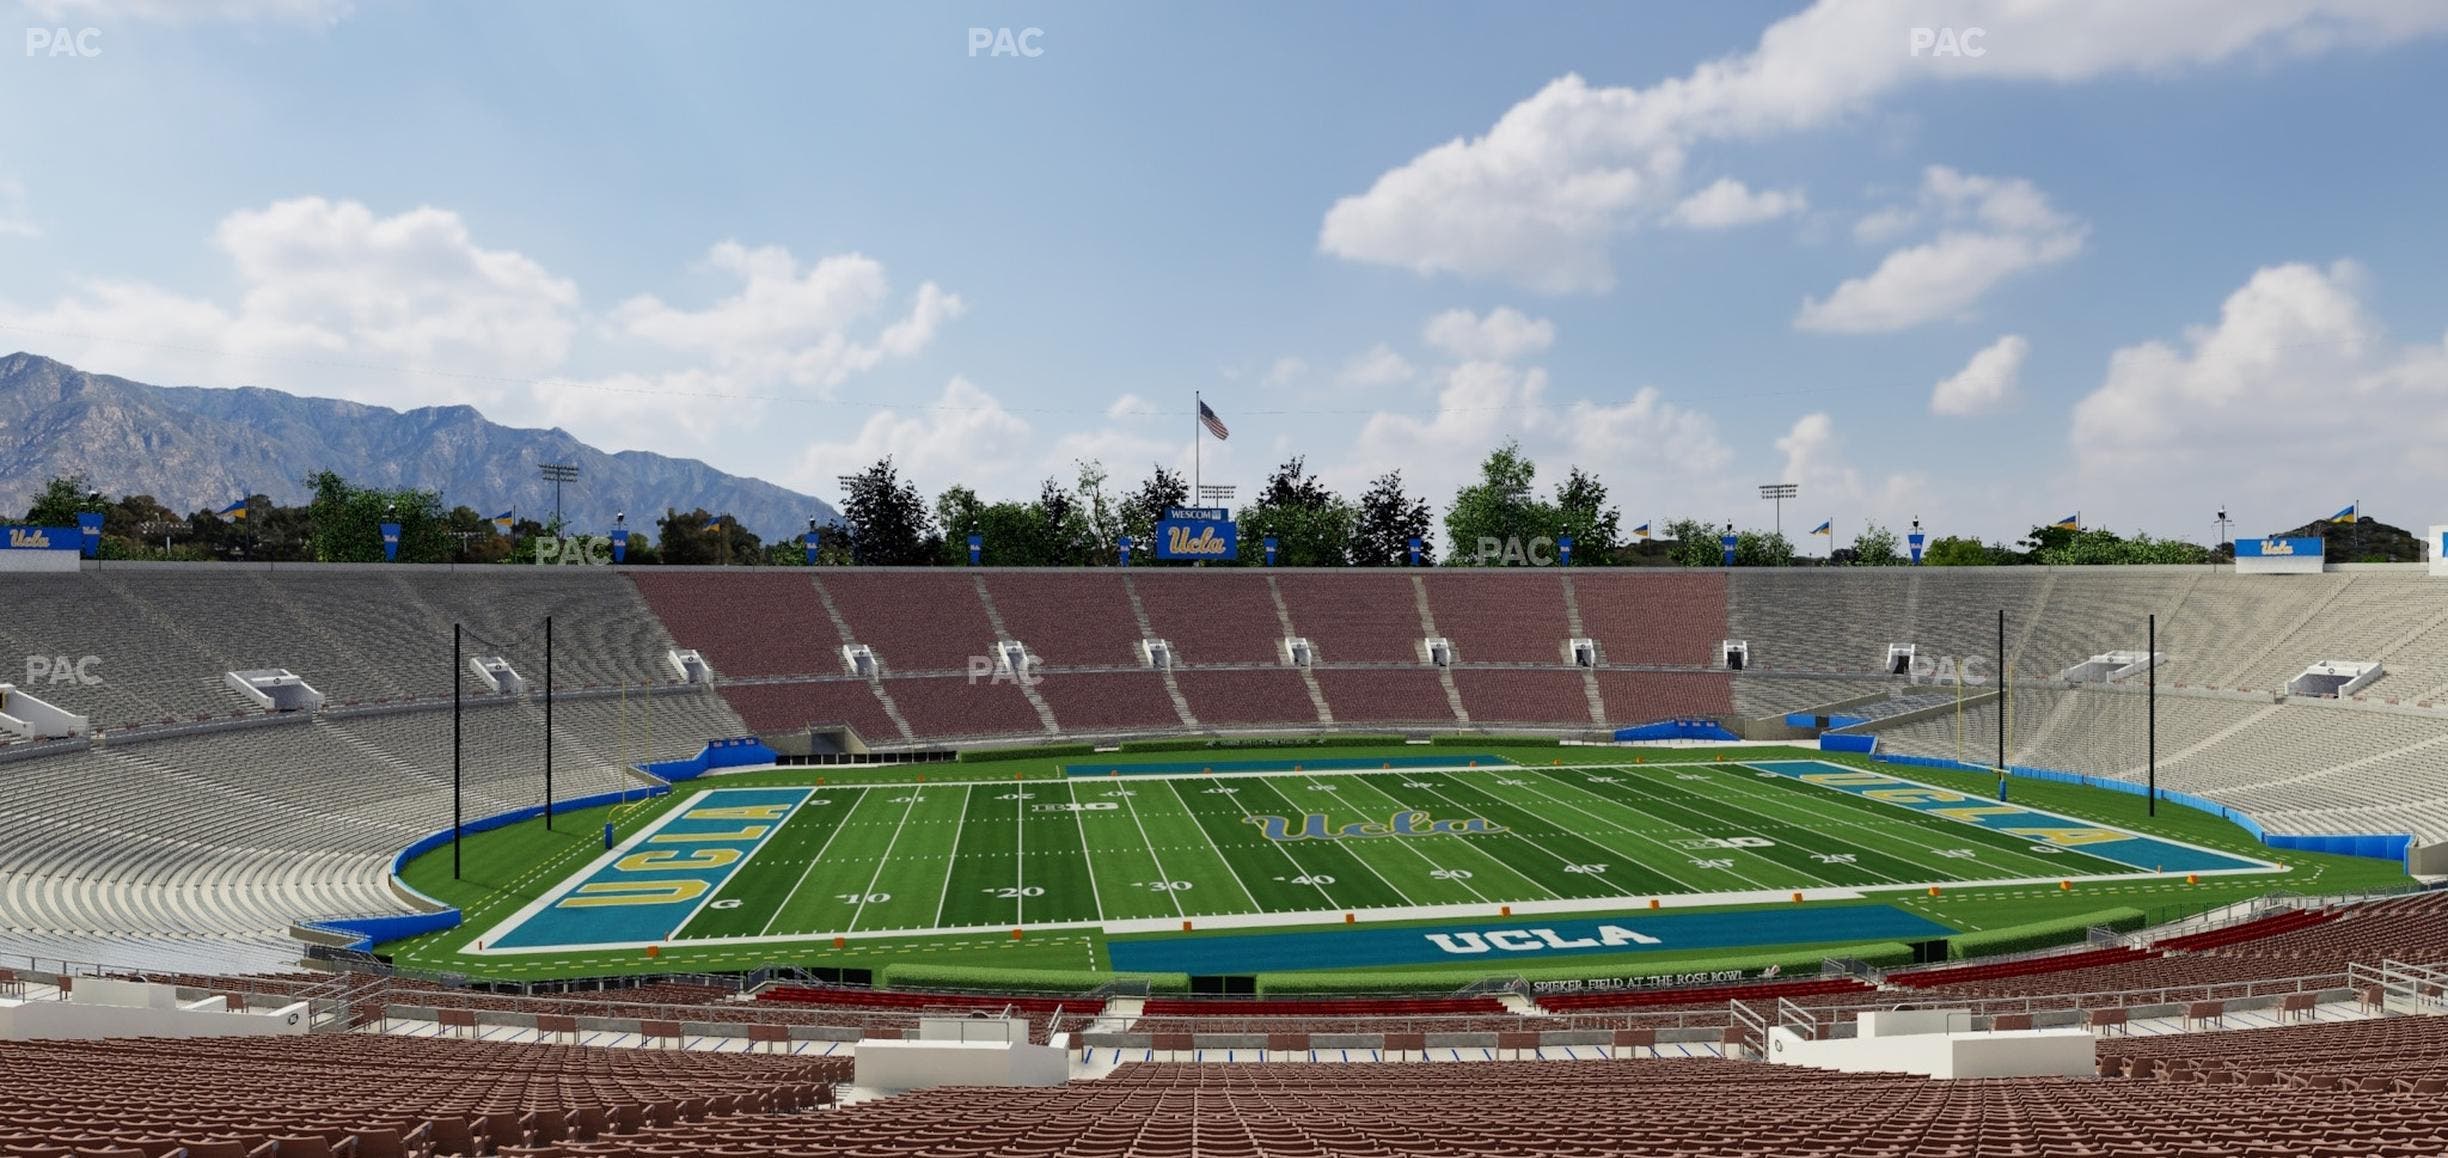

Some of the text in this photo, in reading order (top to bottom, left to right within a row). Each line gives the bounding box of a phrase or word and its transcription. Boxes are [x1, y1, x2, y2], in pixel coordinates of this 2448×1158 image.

[1172, 510, 1211, 520] WESCOM
[556, 803, 792, 908] UCLA
[1429, 869, 1473, 880] 50
[1563, 863, 1606, 874] 40
[1148, 880, 1193, 891] 30
[1291, 874, 1335, 885] 40
[996, 886, 1045, 898] 20
[710, 898, 744, 910] G
[843, 893, 891, 905] 10
[1424, 925, 1662, 954] UCLA
[1534, 970, 1742, 993] SPIEKER FIELD AT THE ROSE BOWL
